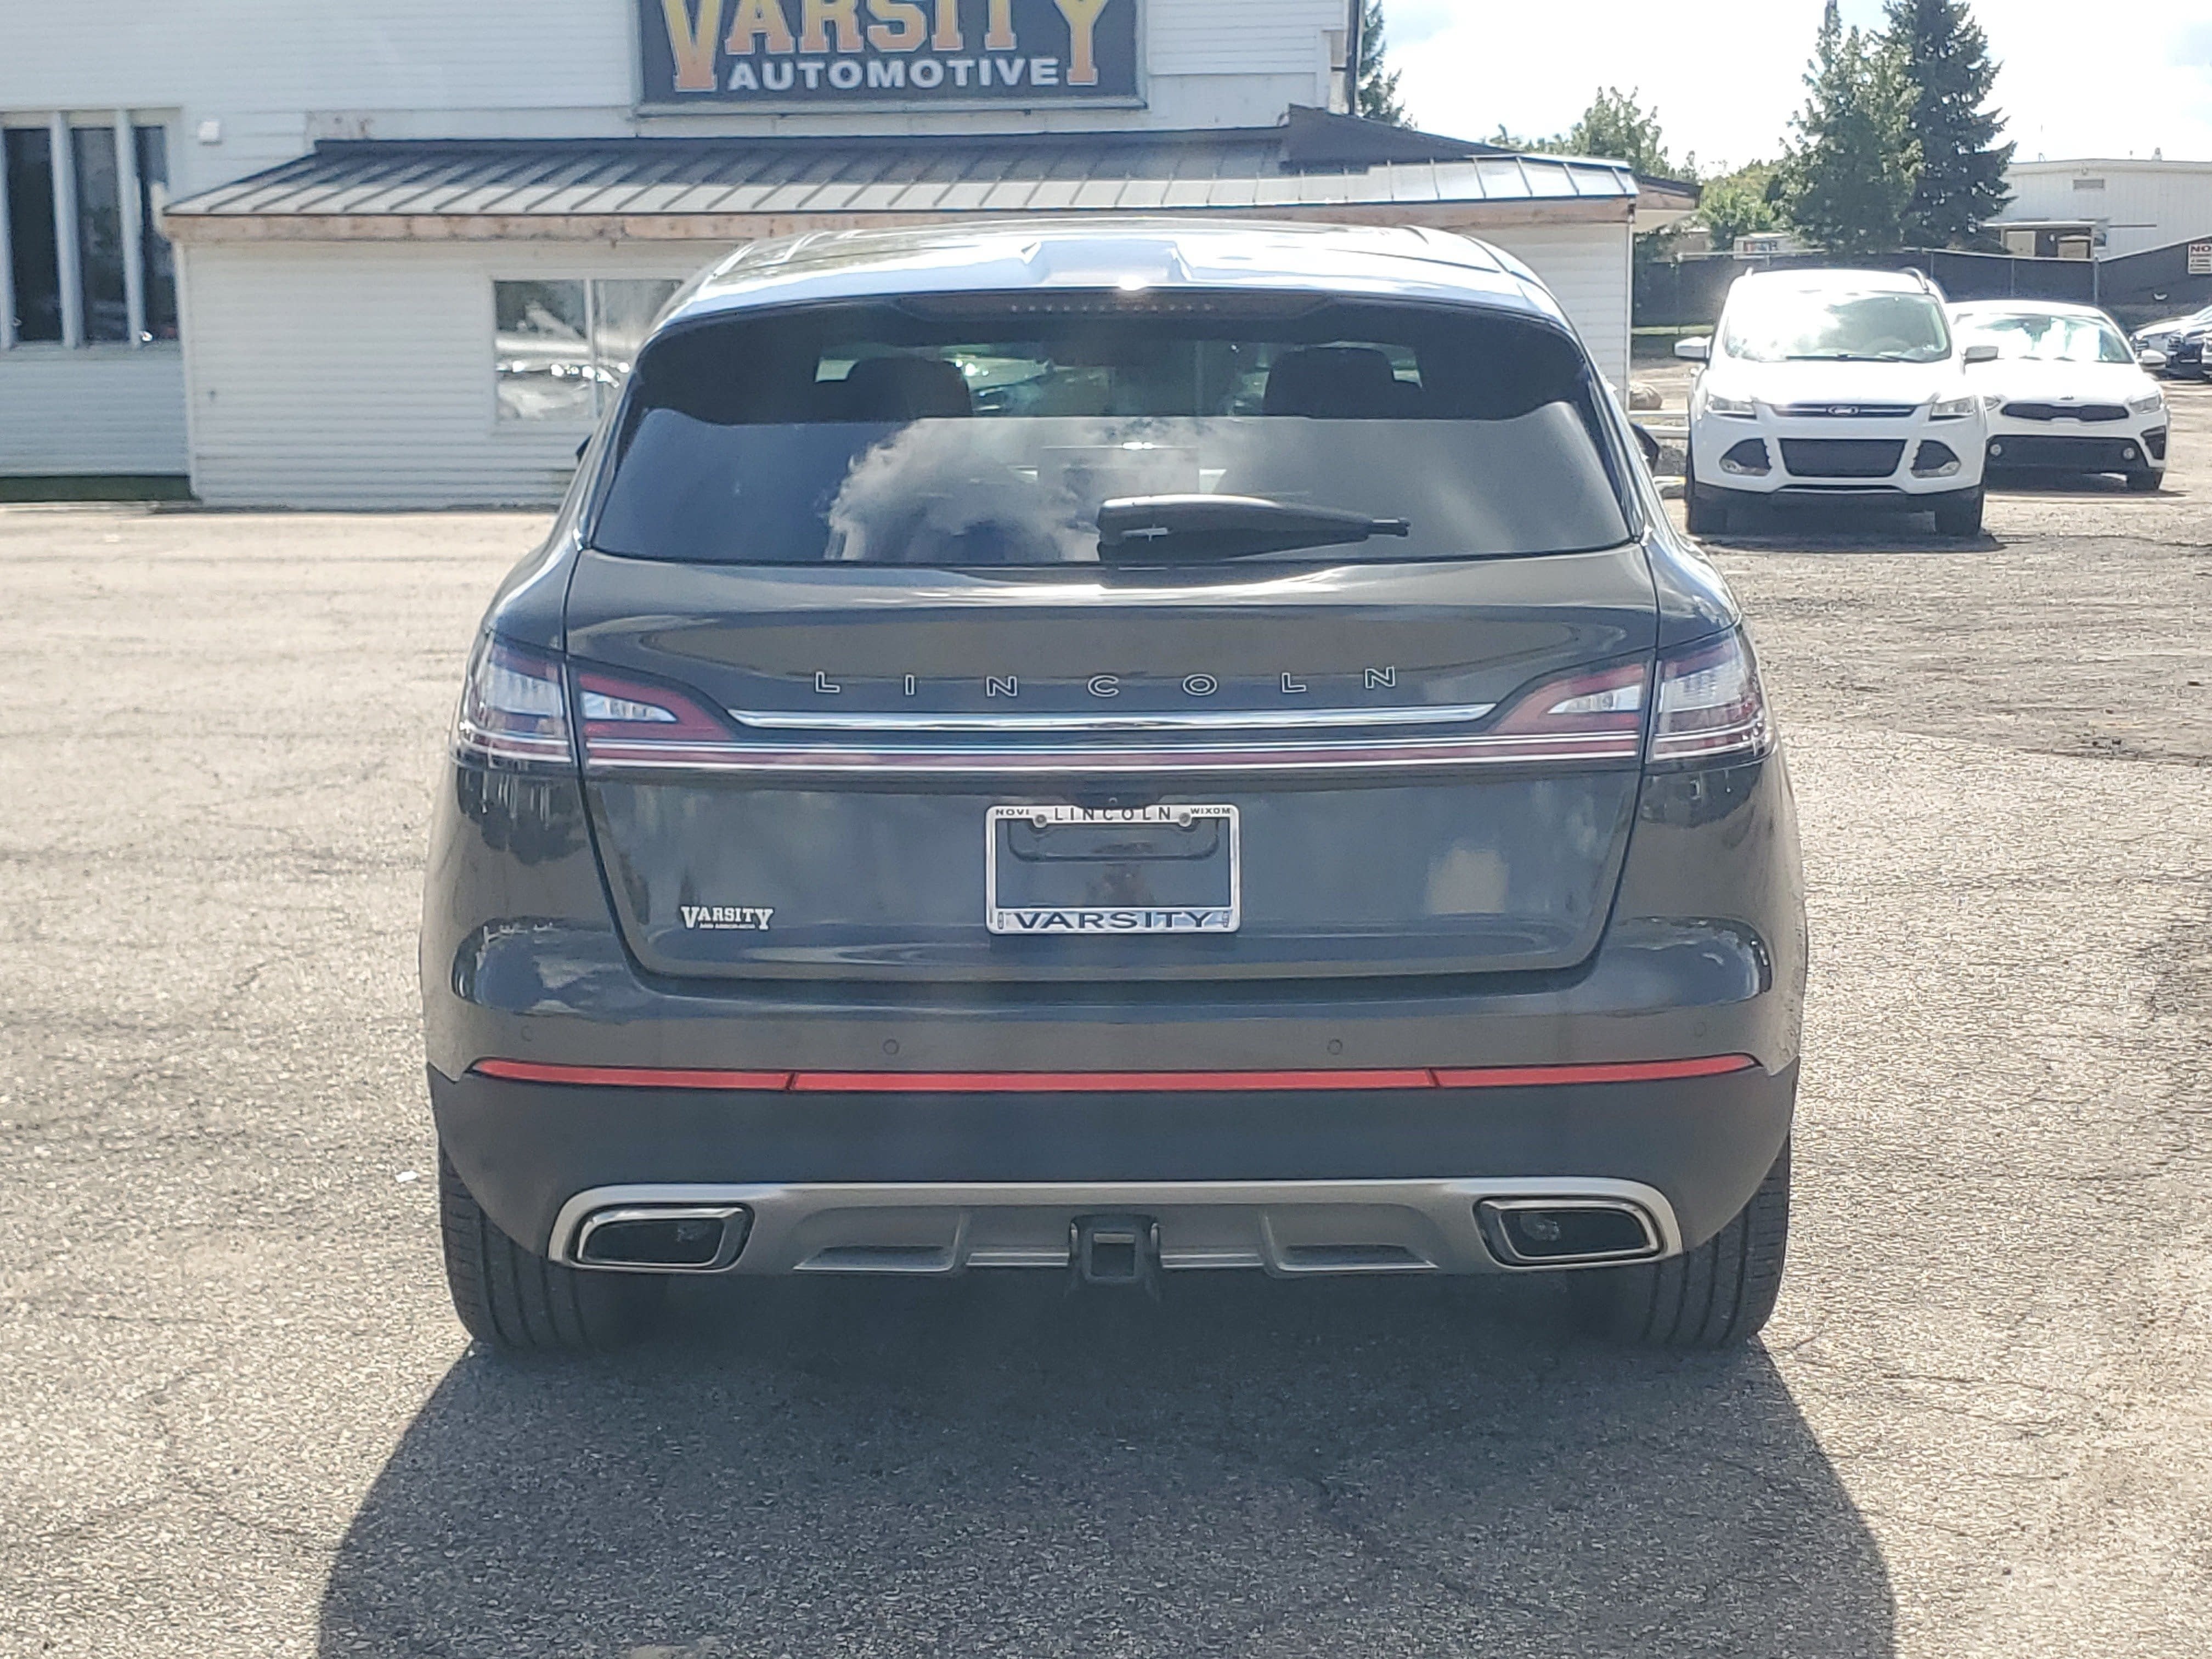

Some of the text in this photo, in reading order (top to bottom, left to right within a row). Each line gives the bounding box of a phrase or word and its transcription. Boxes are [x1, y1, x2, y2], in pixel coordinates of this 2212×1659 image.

[727, 58, 1059, 91] AUTOMOTIVE
[815, 665, 1396, 698] LINCOLN
[1055, 807, 1171, 821] LINCOLN
[681, 906, 774, 931] VARSITY
[1014, 912, 1212, 929] VARSITY
